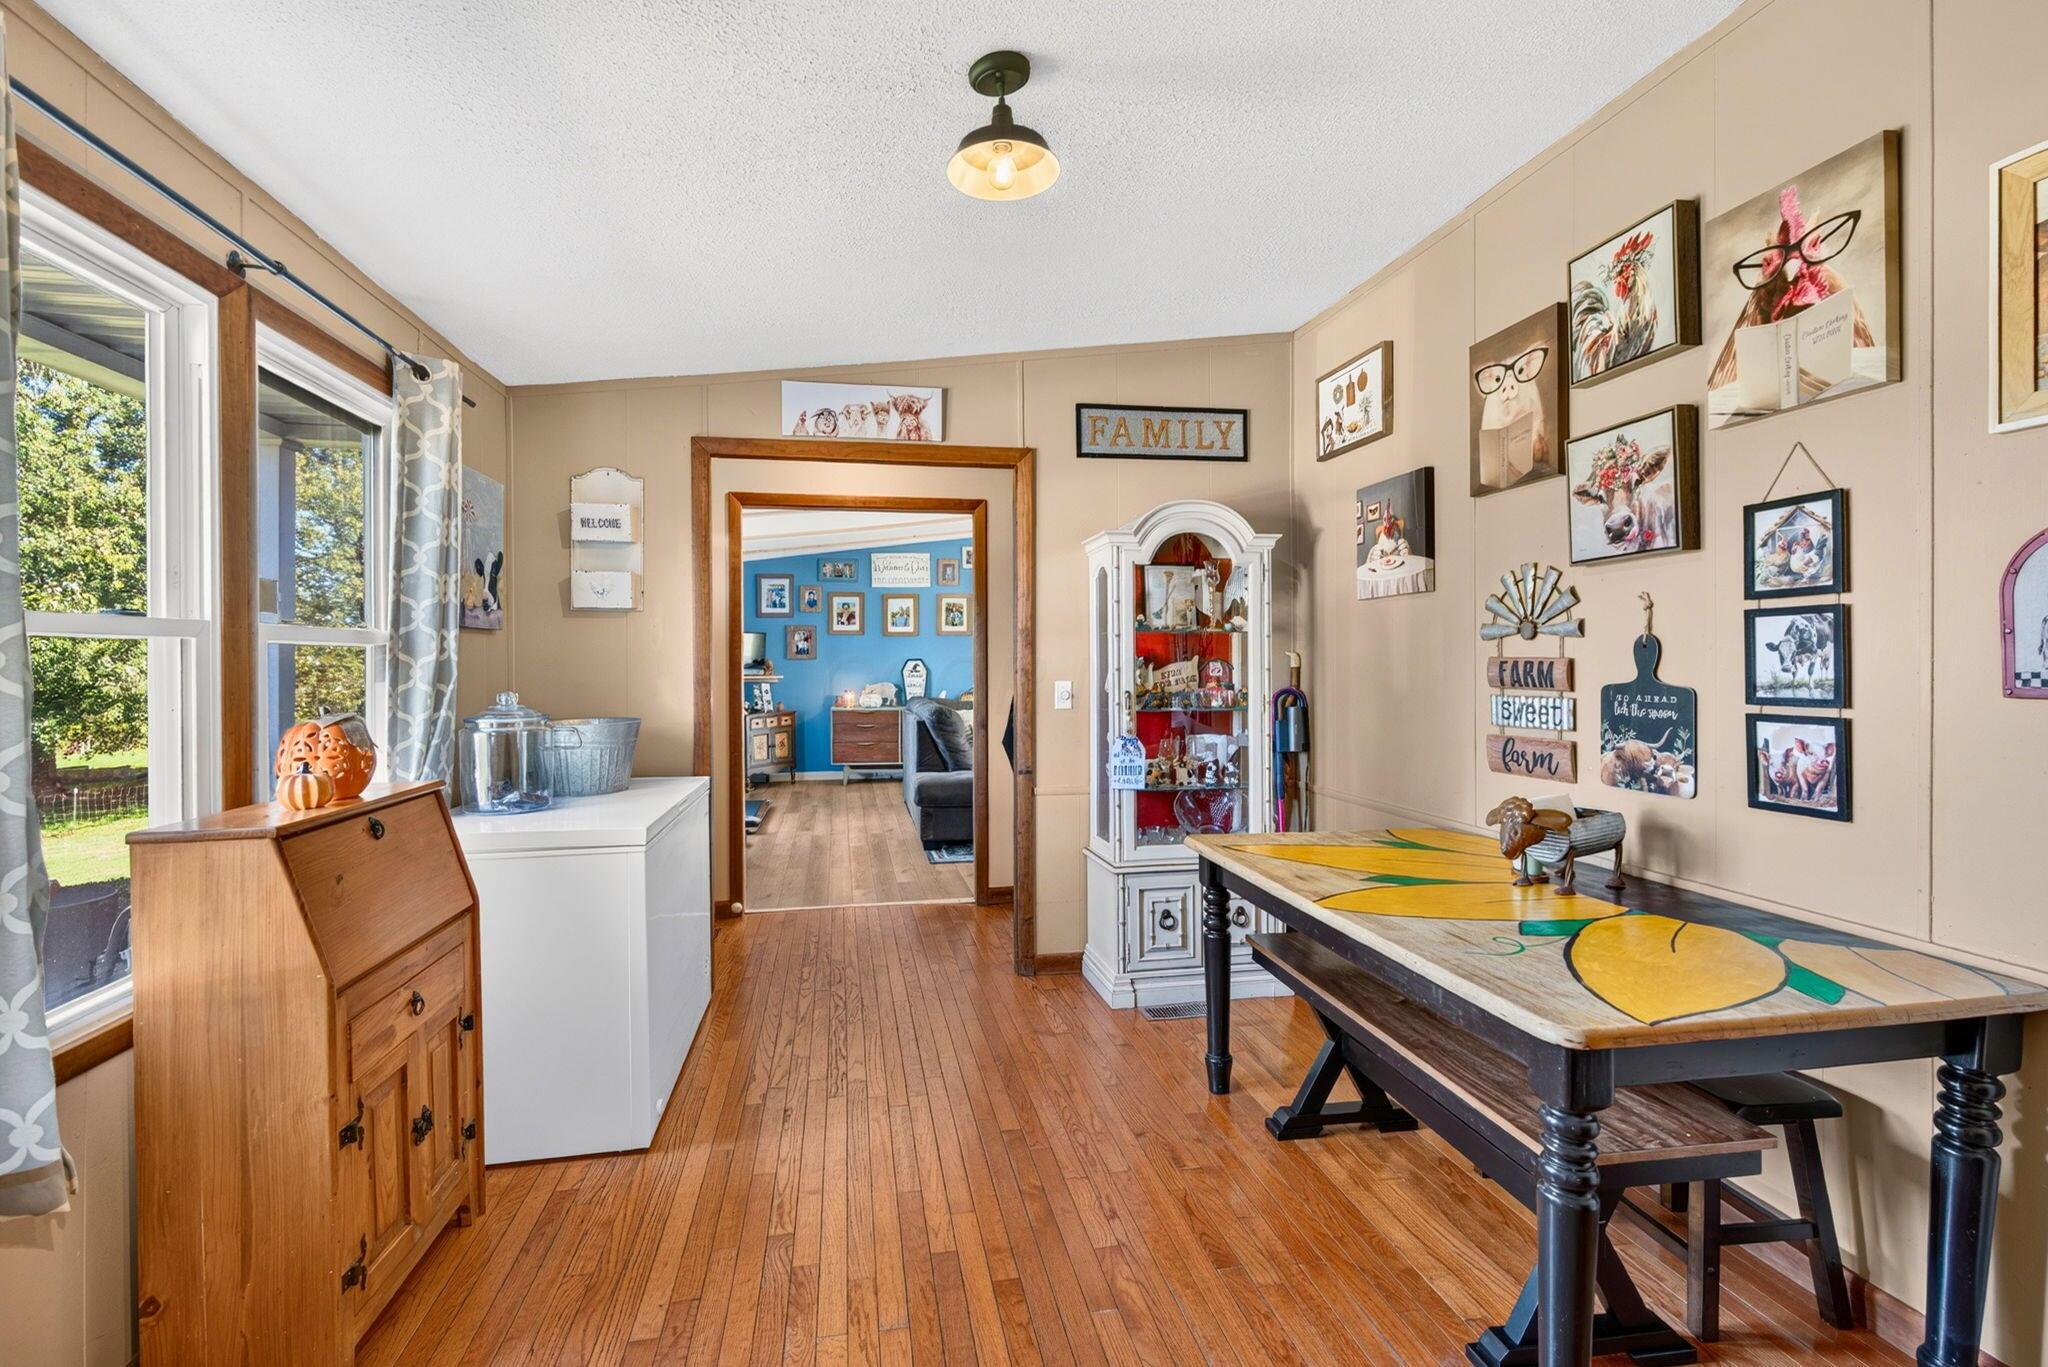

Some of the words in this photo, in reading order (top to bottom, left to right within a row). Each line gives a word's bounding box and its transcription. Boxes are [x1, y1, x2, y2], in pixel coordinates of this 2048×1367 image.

[1088, 415, 1236, 450] FAMILY
[580, 517, 622, 529] WELCOME
[1498, 660, 1555, 689] FARM
[1501, 700, 1563, 727] sweet
[1501, 737, 1560, 776] farm
